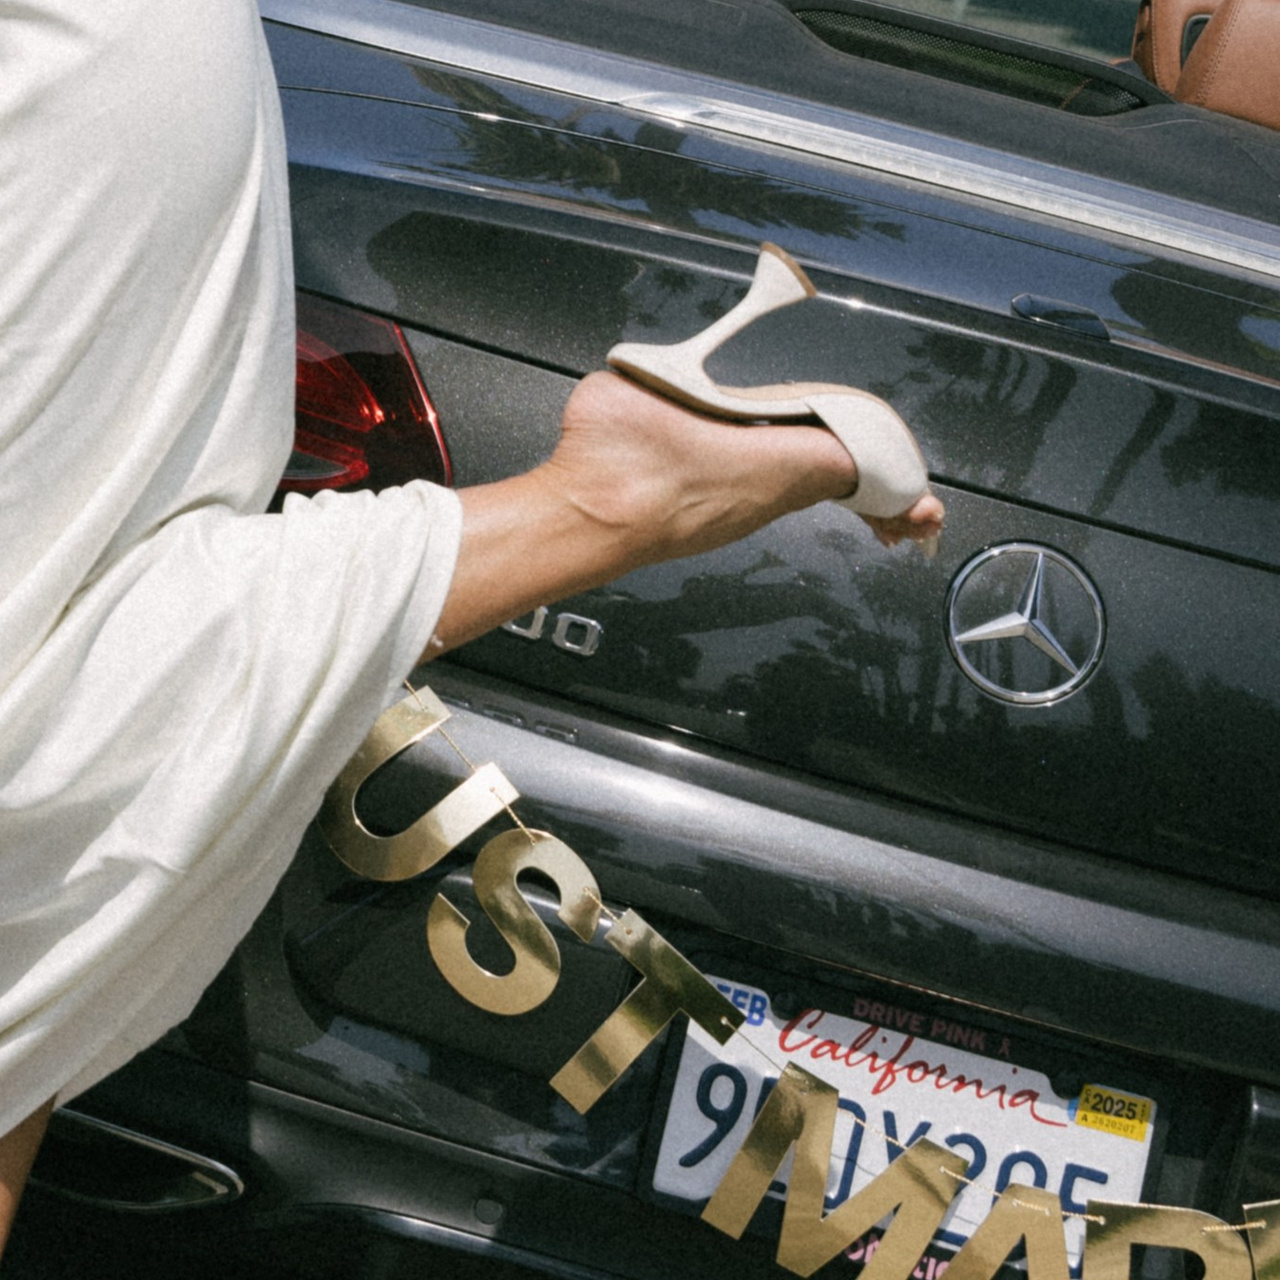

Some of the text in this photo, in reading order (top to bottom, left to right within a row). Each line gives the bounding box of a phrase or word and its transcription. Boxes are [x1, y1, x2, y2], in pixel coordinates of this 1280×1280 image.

[320, 685, 747, 1115] UST
[778, 1007, 1067, 1128] California
[853, 996, 986, 1051] DRIVE PINK
[1090, 1092, 1138, 1120] 2025
